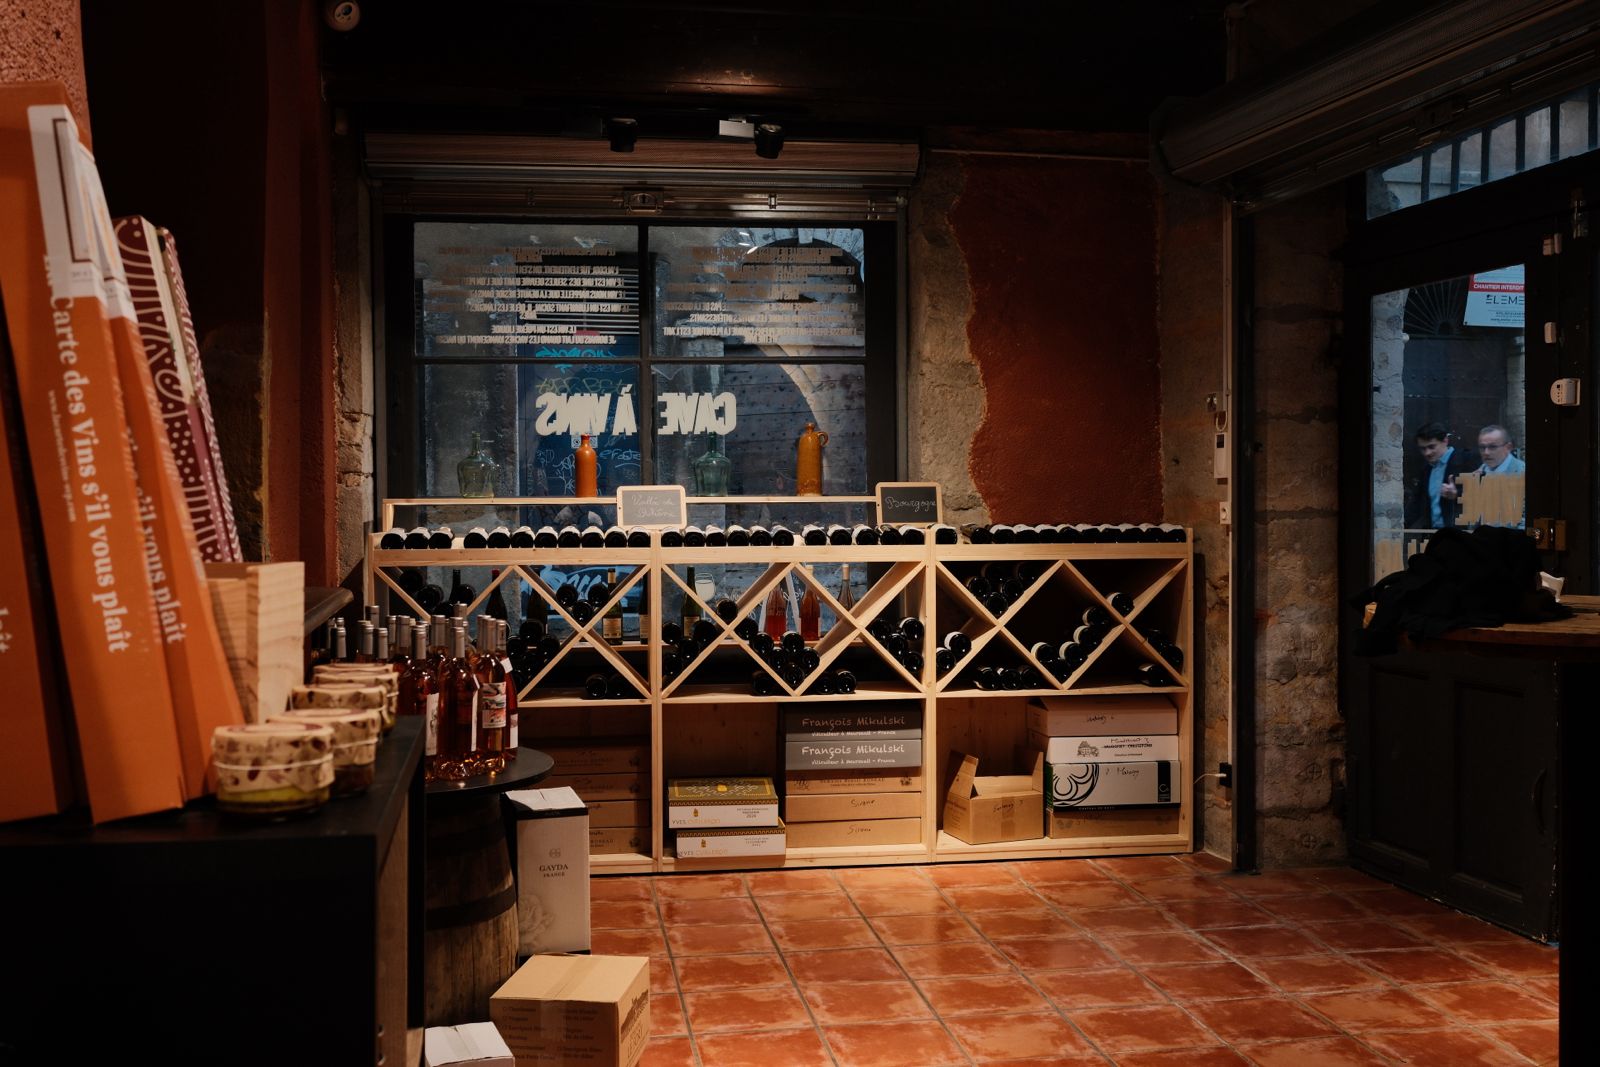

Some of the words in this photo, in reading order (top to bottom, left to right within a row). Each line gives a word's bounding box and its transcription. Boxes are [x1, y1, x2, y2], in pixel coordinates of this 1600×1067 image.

[64, 370, 90, 414] des
[72, 418, 100, 477] Vins
[82, 482, 112, 522] s'il
[885, 497, 936, 512] Bourgogne
[88, 525, 115, 587] vous
[802, 717, 852, 731] François
[857, 716, 905, 726] Mikulski
[802, 746, 851, 759] François
[856, 744, 905, 754] Mikulski
